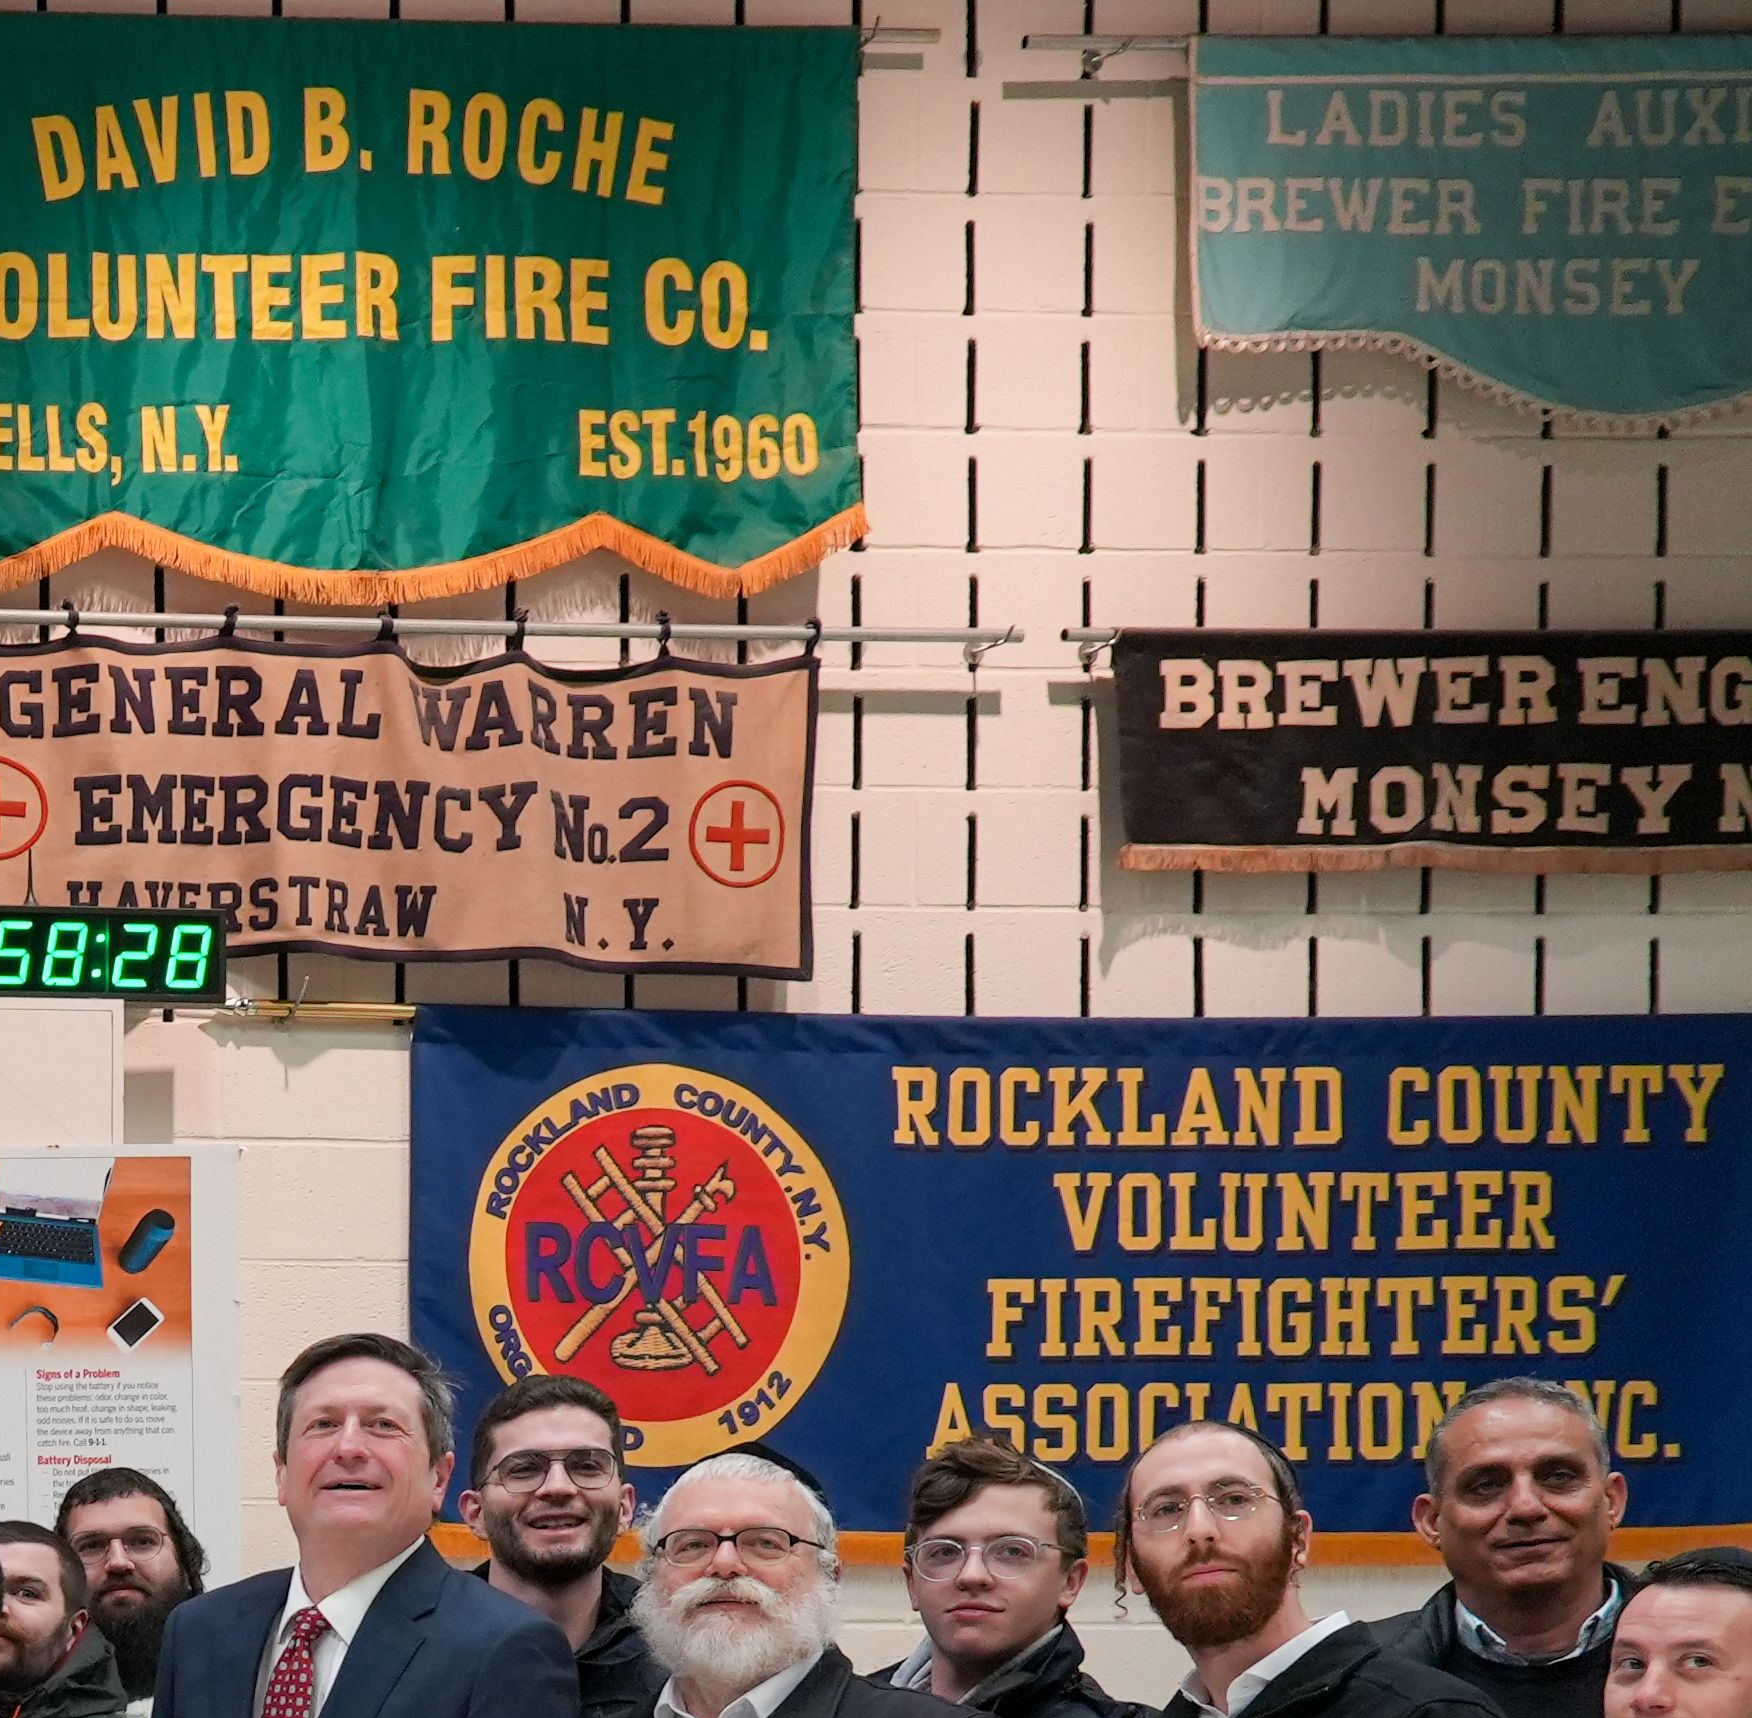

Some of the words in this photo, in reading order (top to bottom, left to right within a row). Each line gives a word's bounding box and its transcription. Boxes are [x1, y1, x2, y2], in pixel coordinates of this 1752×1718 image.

[33, 90, 271, 203] DAVID
[304, 87, 372, 174] B.
[408, 88, 676, 206] ROCHE
[1266, 90, 1528, 149] LADIES
[1196, 175, 1482, 235] BREWER
[1522, 178, 1682, 235] FIRE
[431, 254, 610, 345] FIRE
[643, 257, 768, 352] CO.
[1415, 257, 1701, 316] MONSEY
[141, 403, 239, 474] N.Y.
[410, 675, 738, 762] WARREN
[1158, 654, 1559, 730] BREWER
[72, 774, 540, 854] EMERGENCY
[1296, 763, 1693, 838] MONSEY
[891, 1066, 1344, 1148] ROCKLAND
[1385, 1067, 1726, 1148] COUNTY
[487, 1084, 640, 1219] ROCKLAND
[1051, 1170, 1556, 1254] VOLUNTEER
[524, 1221, 777, 1306] RCVFA
[718, 1371, 792, 1434] 1912
[37, 1456, 71, 1467] Battery
[74, 1455, 111, 1466] Disposal
